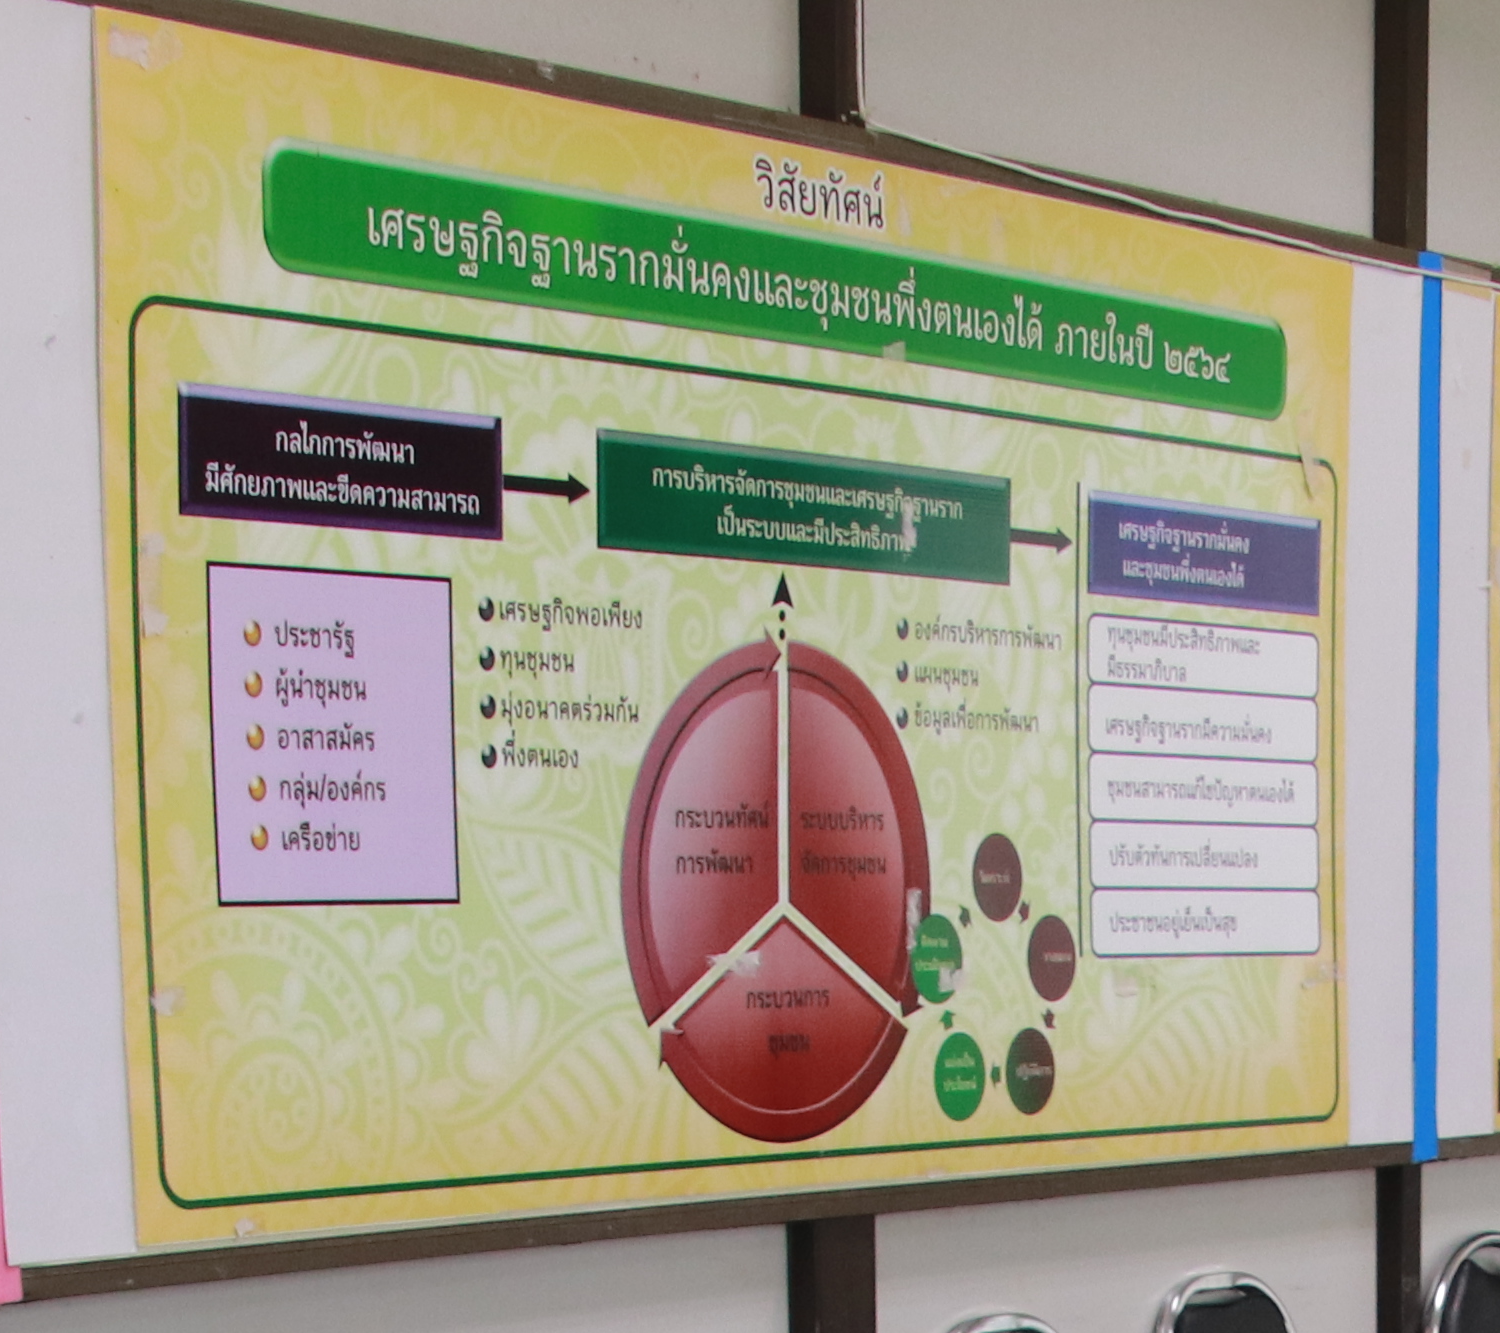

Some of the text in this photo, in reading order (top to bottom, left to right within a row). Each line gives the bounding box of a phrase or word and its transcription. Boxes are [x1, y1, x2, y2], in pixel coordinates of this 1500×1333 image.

[755, 154, 885, 231] วิสัยทัศน์
[367, 206, 1231, 383] เศรษฐกิจฐานรากมั่นคงและชุมชนพึ่งตนเองได้ ภายในปี ๒๕๖๔
[275, 421, 415, 464] กลไกการพัฒนา
[205, 462, 480, 515] มีศักยภาพและขีดความสามารถ
[717, 504, 916, 552] เป็นระบบและมีประสิทธิภา
[1119, 520, 1249, 554] เศรษฐกิจฐานรากมั่นคง
[499, 597, 642, 631] เศรษฐกิจพอเพียง
[274, 619, 355, 659] ประชารัฐ
[915, 615, 1062, 652] องค์กรบริหารการพัฒนา
[499, 649, 575, 680] ทุนชุมชน
[915, 663, 980, 693] แผนชุมชน
[1107, 657, 1187, 682] มีธรรมาภิบาล
[275, 667, 367, 709] ผู้นำชุมชน
[501, 693, 640, 729] มุ่งอนาคตร่วมกัน
[915, 699, 1040, 736] ข้อมูลเพื่อการพัฒนา
[277, 722, 375, 752] อาสาสมัคร
[502, 731, 579, 770] พึ่งตนเอง
[279, 770, 386, 809] กลุ่ม/องค์กร
[675, 800, 769, 830] กระบวนทัศน์
[801, 805, 884, 831] ระบบบริหาร
[281, 822, 361, 851] เครือข่าย
[675, 849, 753, 875] การพัฒนา
[746, 988, 830, 1010] กระบวนการ
